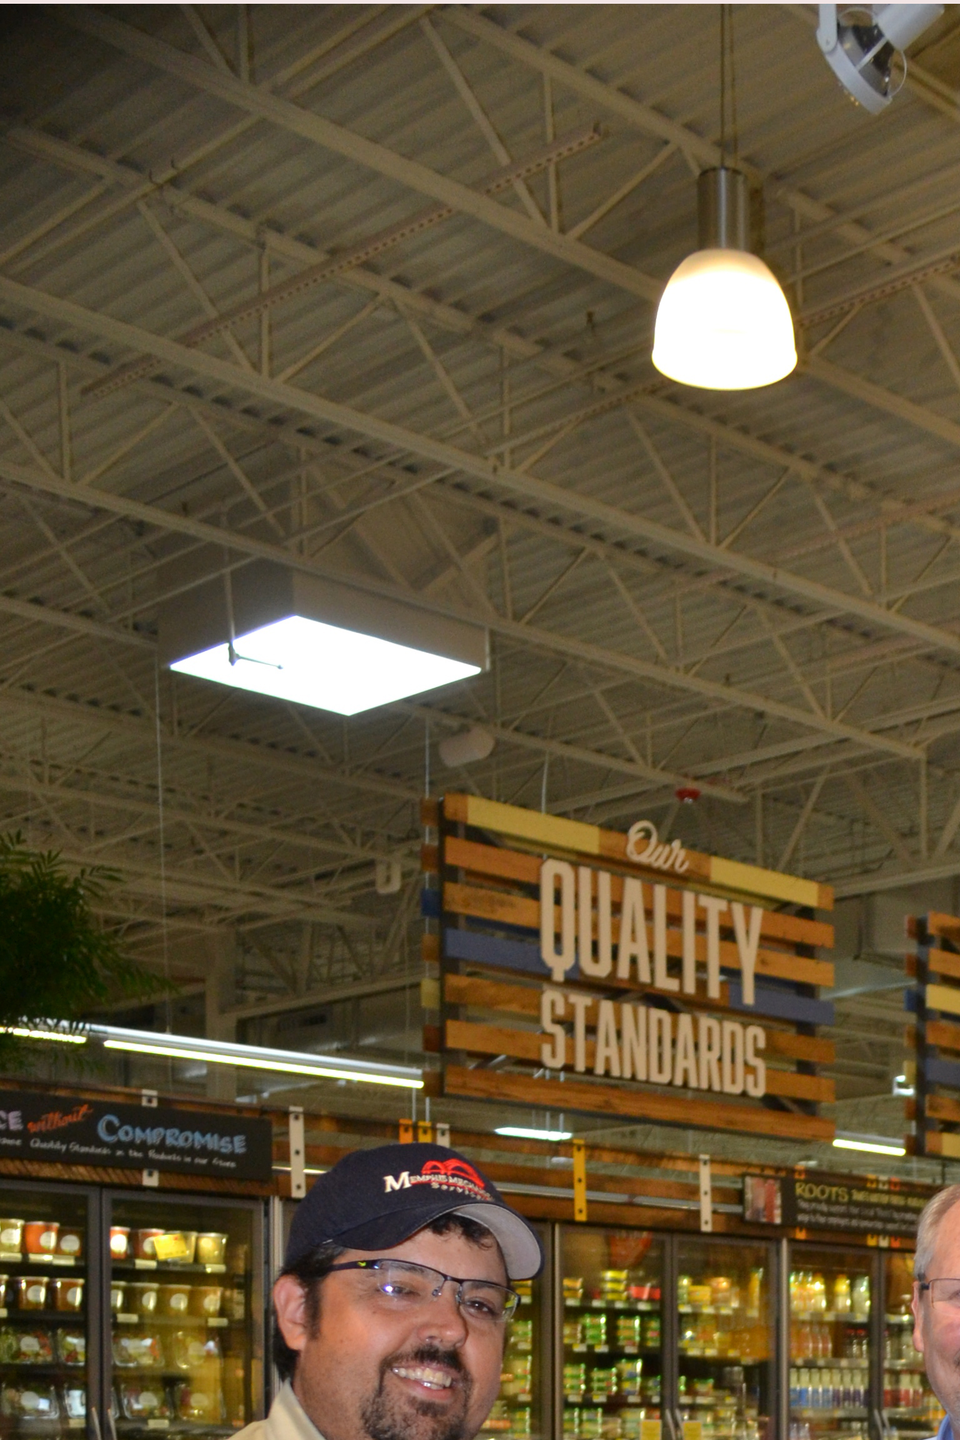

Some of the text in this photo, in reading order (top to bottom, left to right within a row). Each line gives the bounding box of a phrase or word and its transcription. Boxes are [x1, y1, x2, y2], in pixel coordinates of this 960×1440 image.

[626, 820, 689, 873] Our
[541, 858, 763, 1006] QUALITY
[541, 989, 766, 1098] STANDARDS
[97, 1113, 247, 1155] COMPROMISE
[795, 1182, 849, 1202] ROOTS
